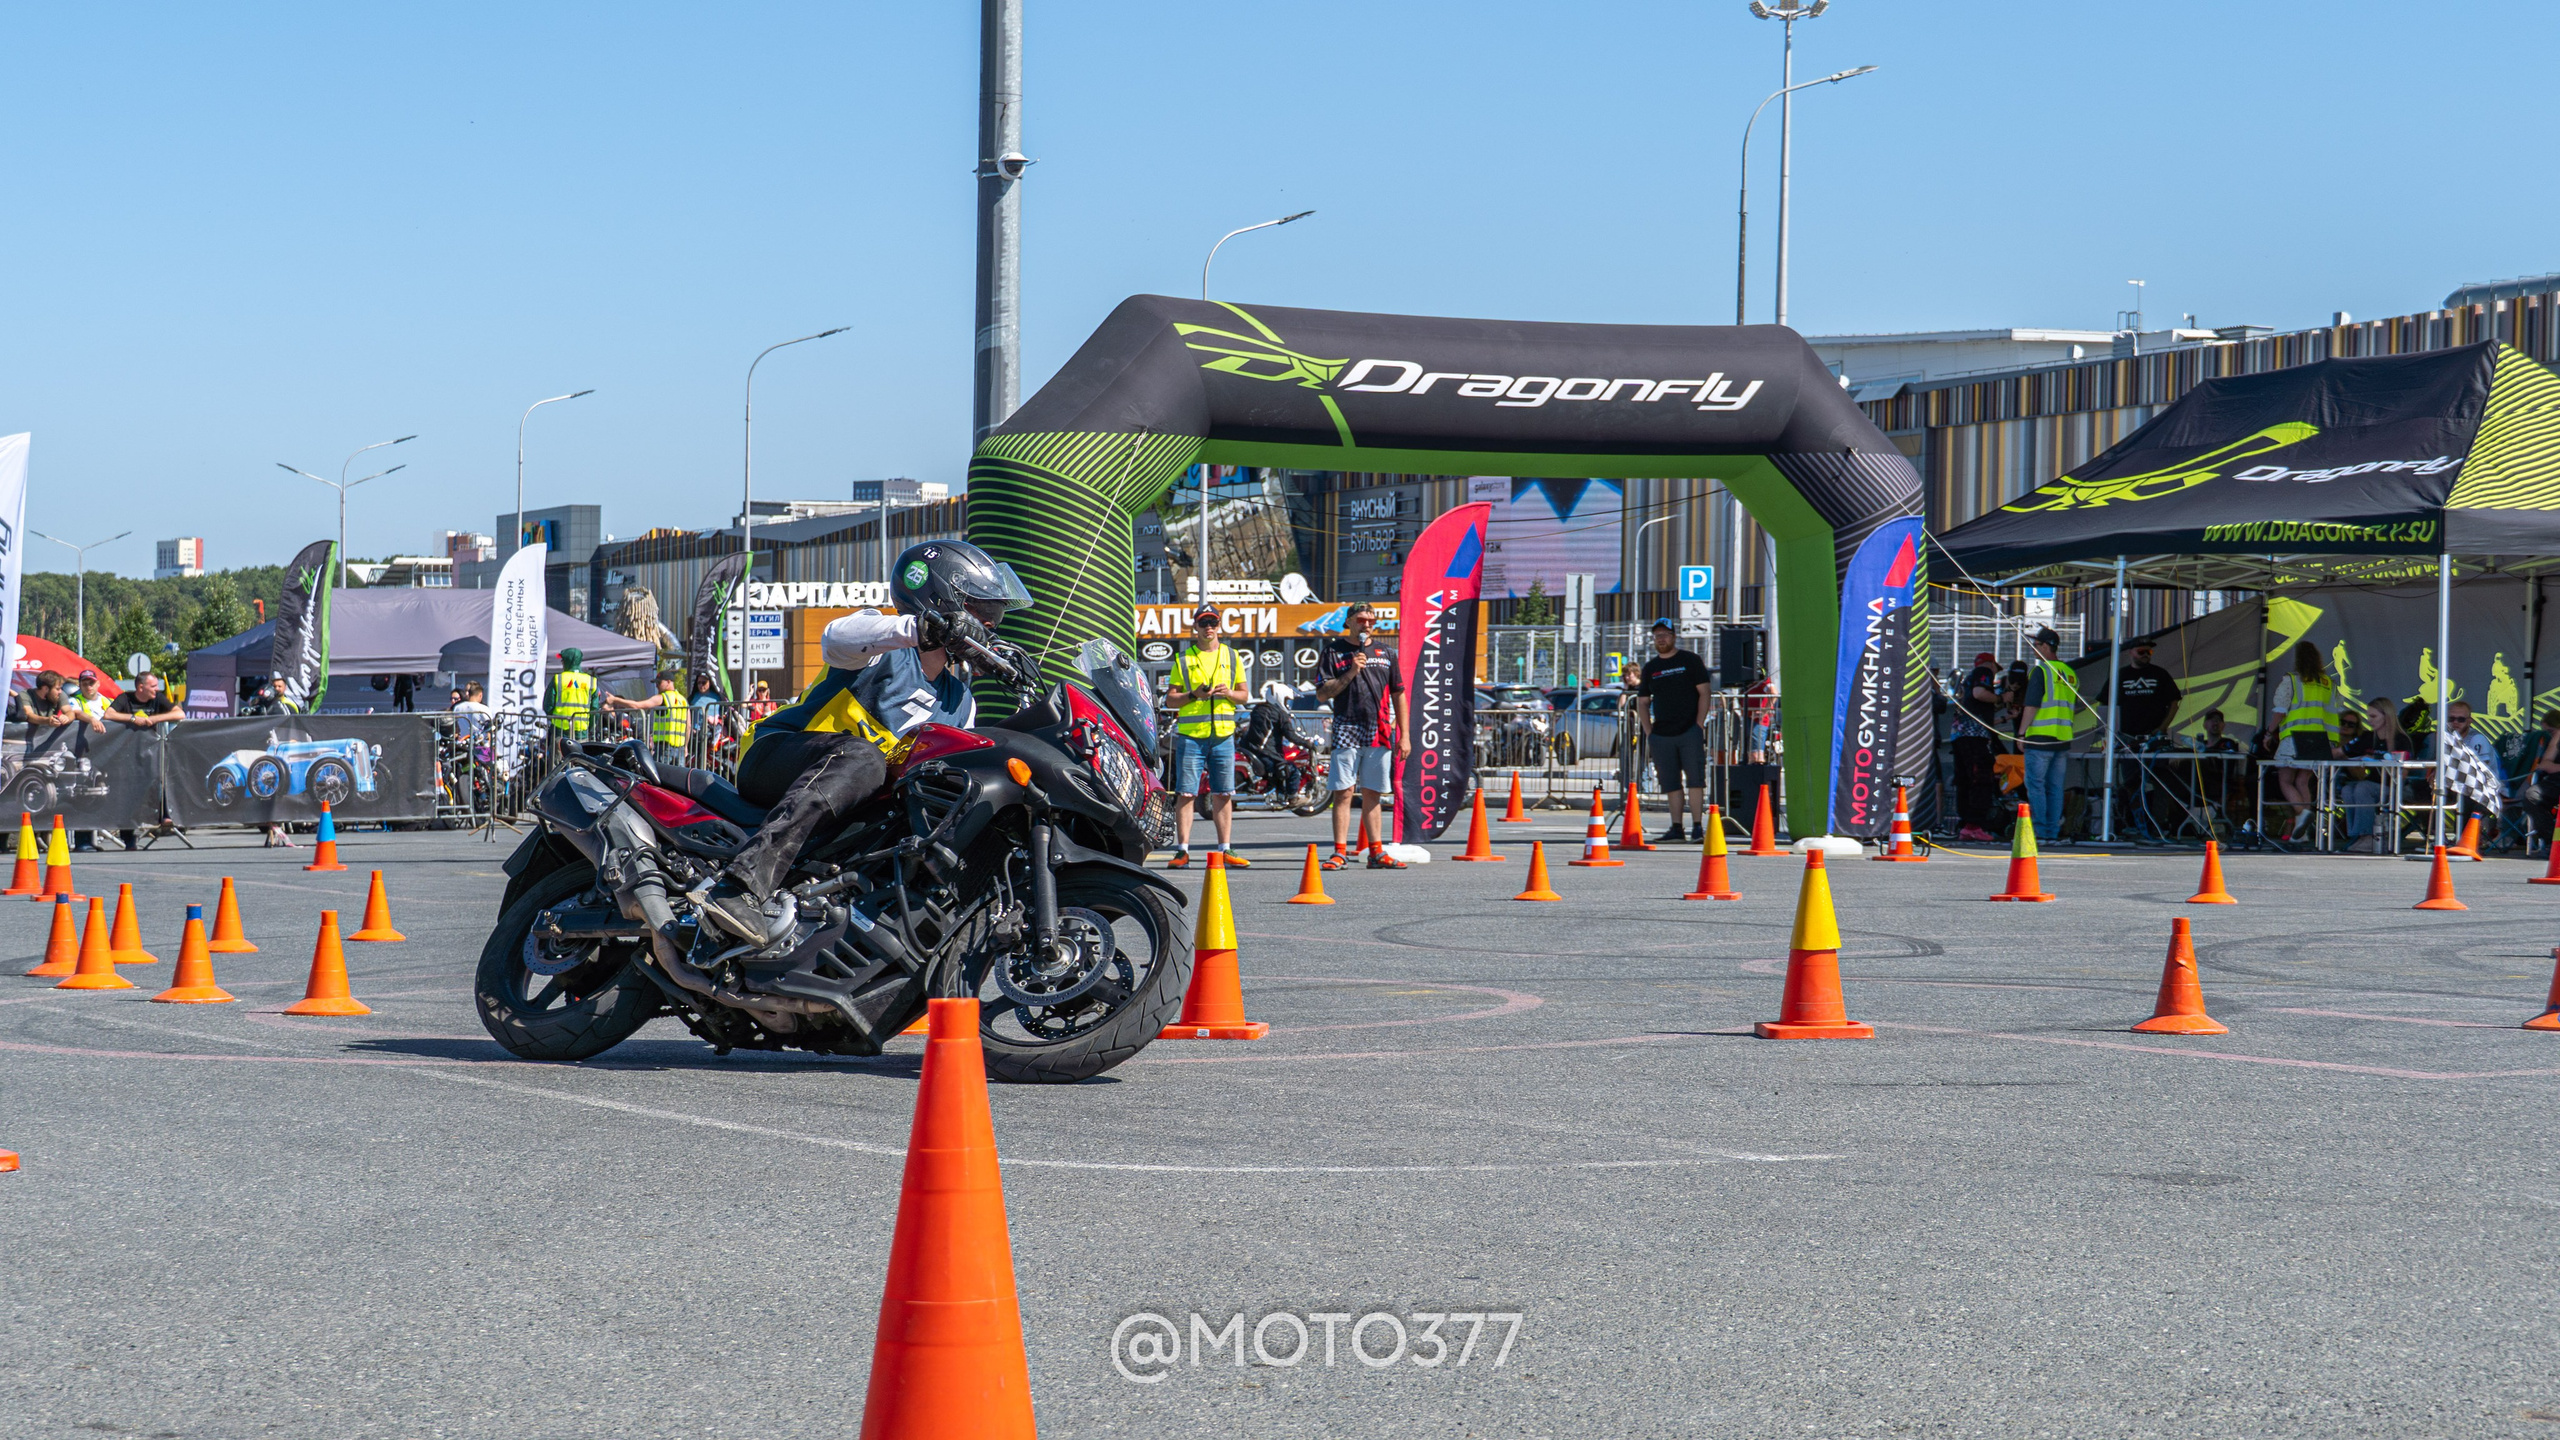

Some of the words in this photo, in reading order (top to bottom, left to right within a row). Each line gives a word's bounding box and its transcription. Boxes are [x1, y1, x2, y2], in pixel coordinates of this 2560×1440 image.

[2203, 520, 2436, 541] WWW.DRAGON-FLY.SU
[906, 565, 925, 585] 26
[503, 580, 514, 655] МОТОСАЛОН
[516, 578, 525, 656] УВЛЕЧЁННЫХ
[529, 615, 538, 656] ЛЮДЕЙ
[751, 615, 780, 623] .ТАГИЛ
[1135, 607, 1277, 635] АПЧСТИ
[750, 657, 778, 665] ОКЗАЛ
[1420, 590, 1444, 831] MOTOGYMKHANA
[1436, 662, 1454, 828] EKATERINBURG
[1446, 589, 1459, 645] TEAM
[1850, 596, 1884, 825] MOTOGYMKHANA
[1869, 666, 1892, 825] EKATERINBURG
[1884, 596, 1897, 650] TEAM
